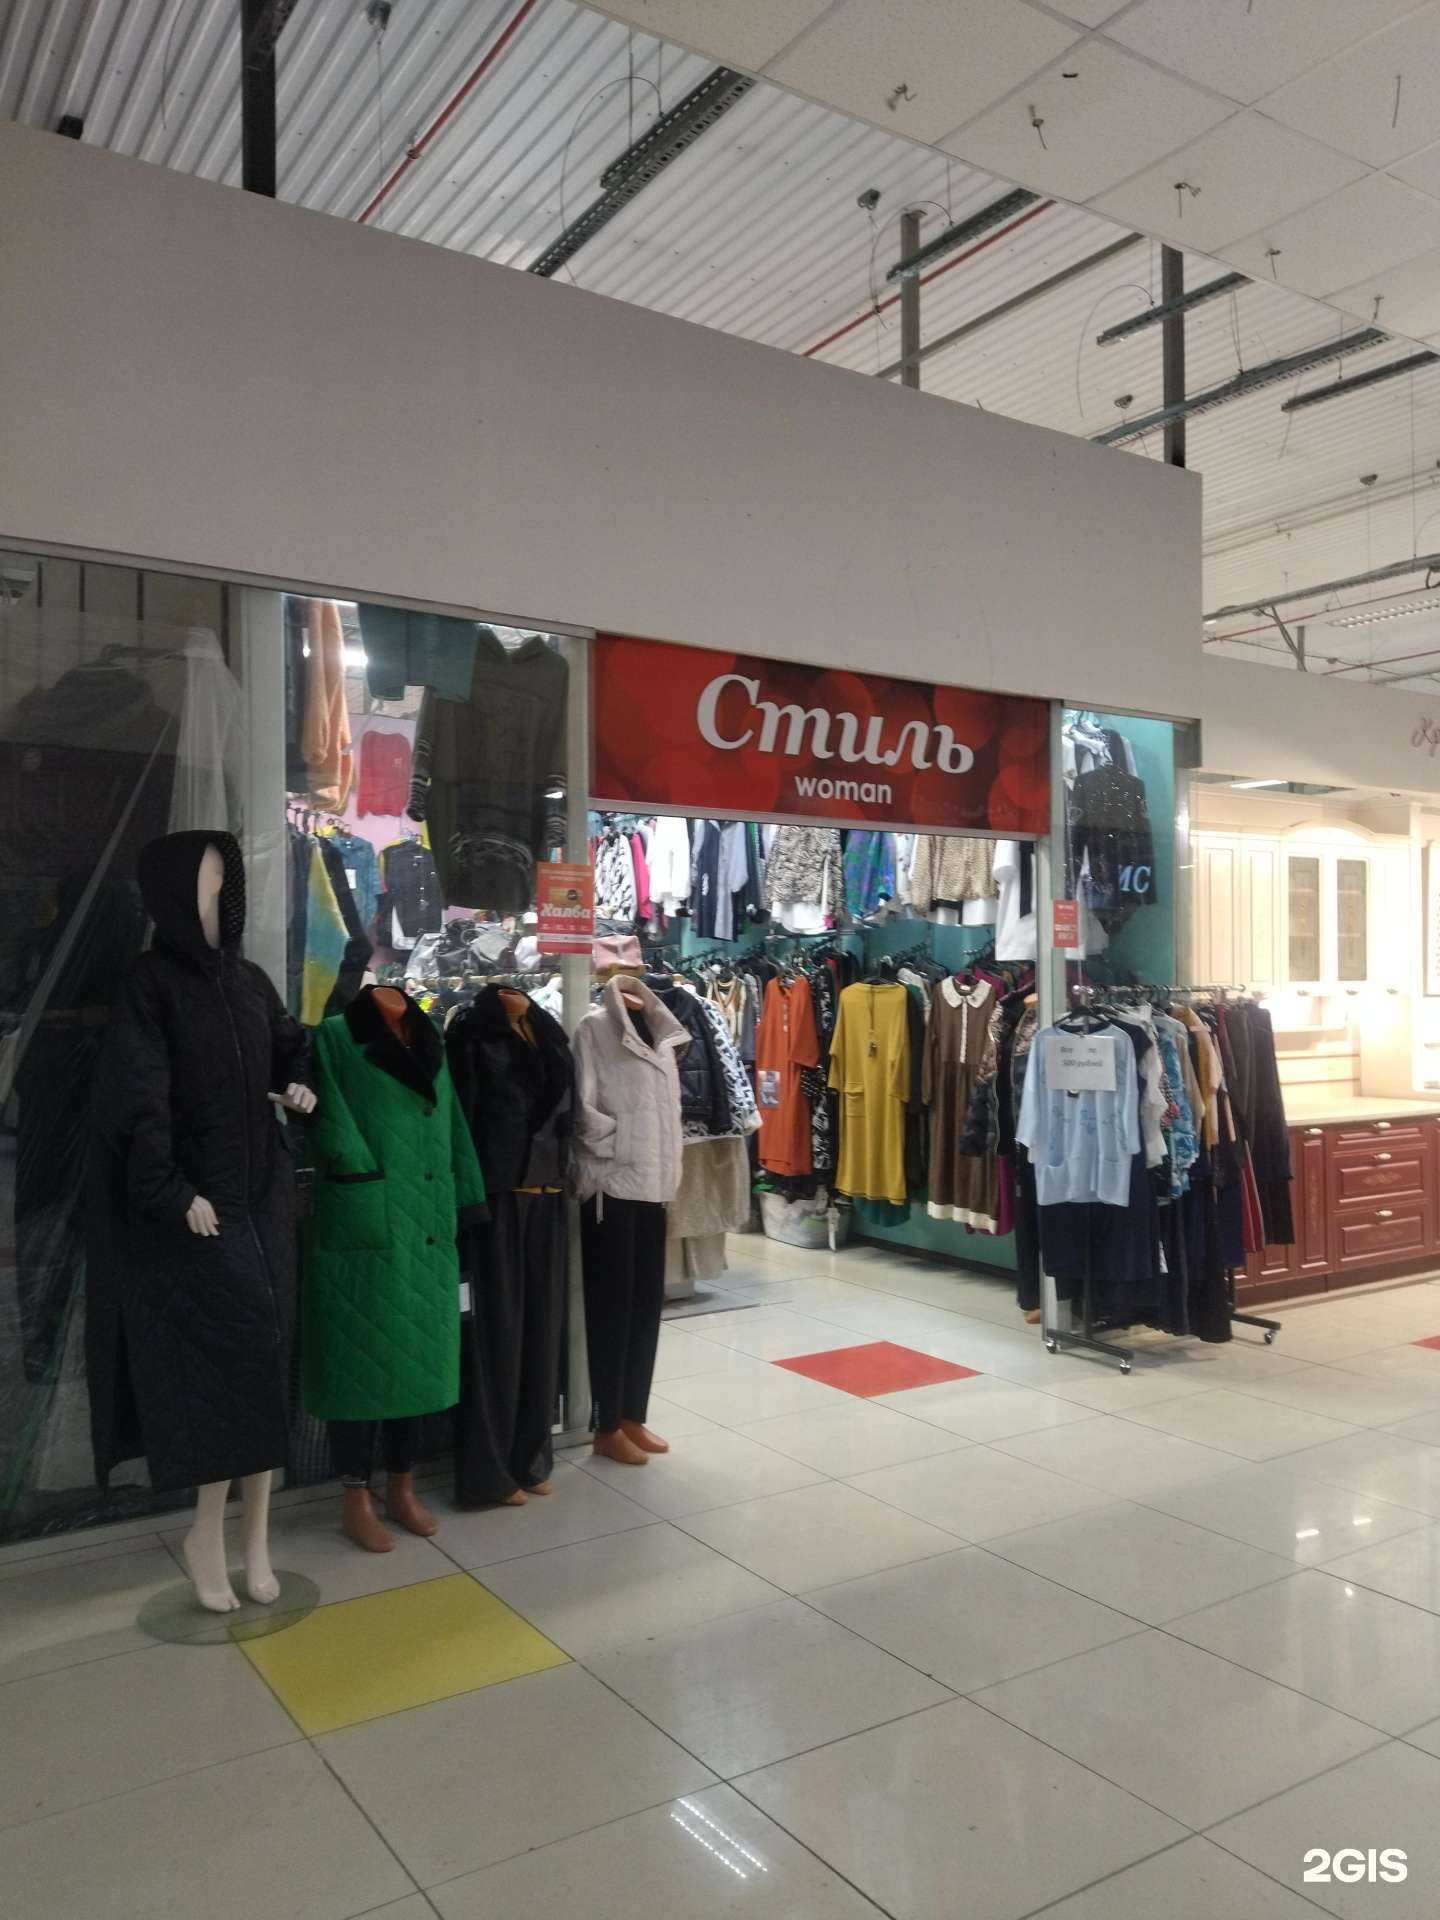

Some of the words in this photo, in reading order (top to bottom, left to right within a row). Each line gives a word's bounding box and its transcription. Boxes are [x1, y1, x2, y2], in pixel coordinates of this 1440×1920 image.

[696, 673, 974, 774] Стиль
[795, 775, 893, 805] woman
[540, 902, 592, 919] Халва
